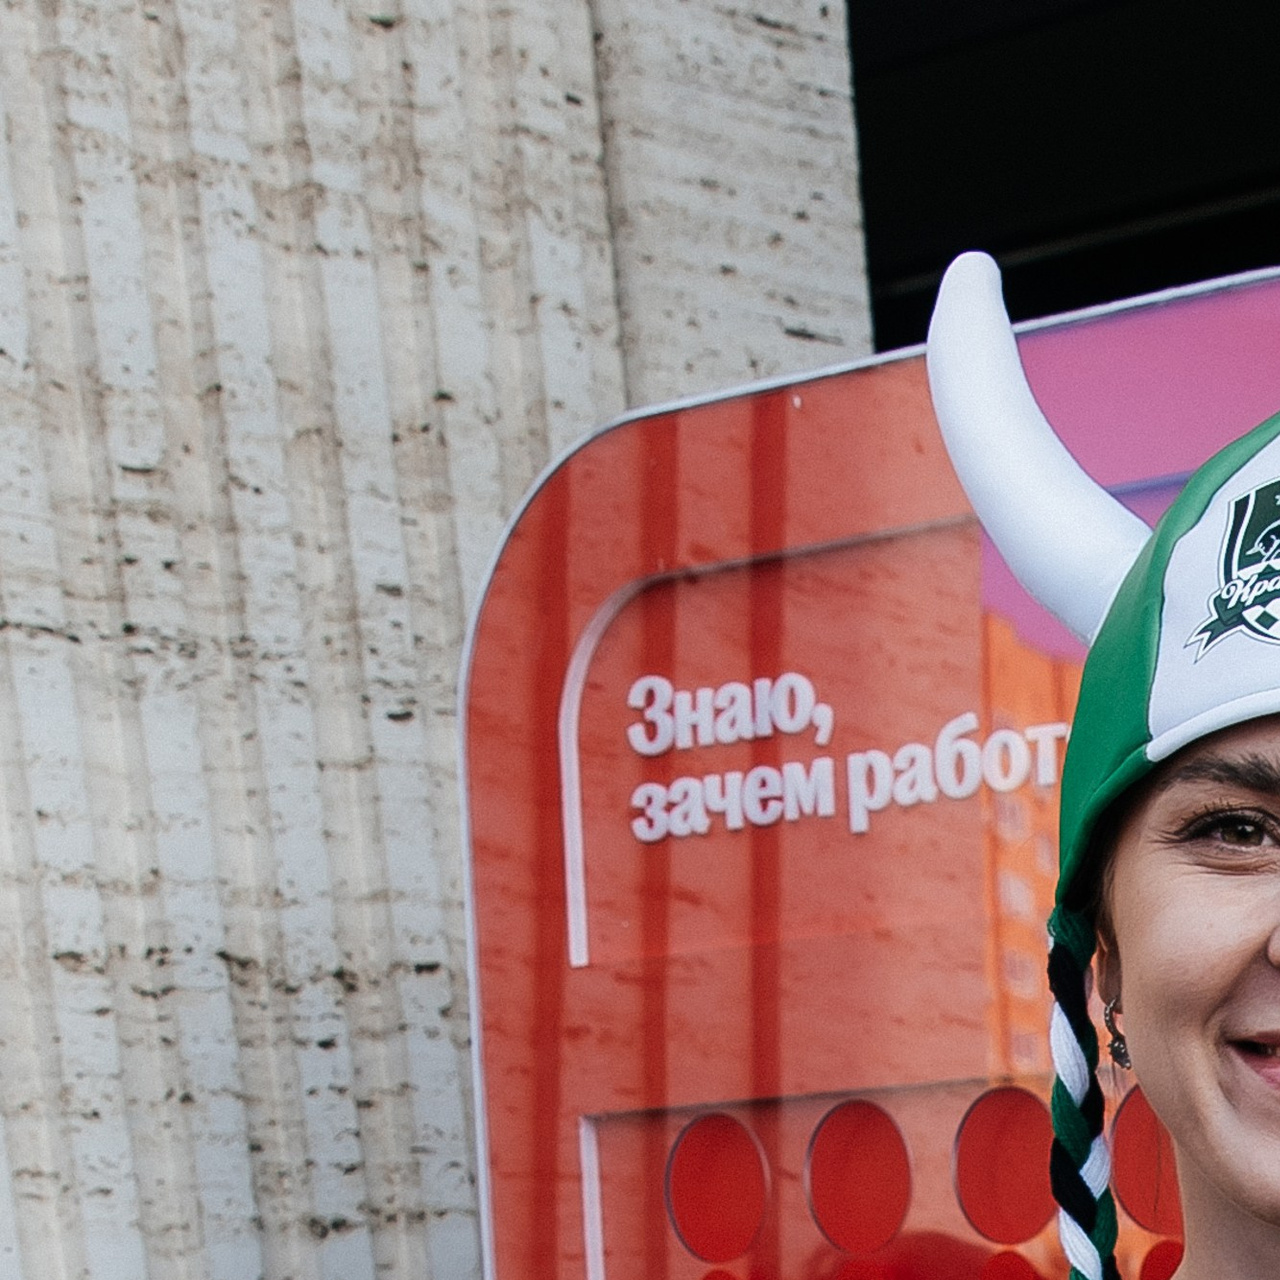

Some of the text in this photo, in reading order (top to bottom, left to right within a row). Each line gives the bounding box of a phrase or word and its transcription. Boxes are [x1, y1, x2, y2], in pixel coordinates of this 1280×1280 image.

[626, 672, 835, 757] Знаю,
[629, 710, 1071, 843] зачем работ
